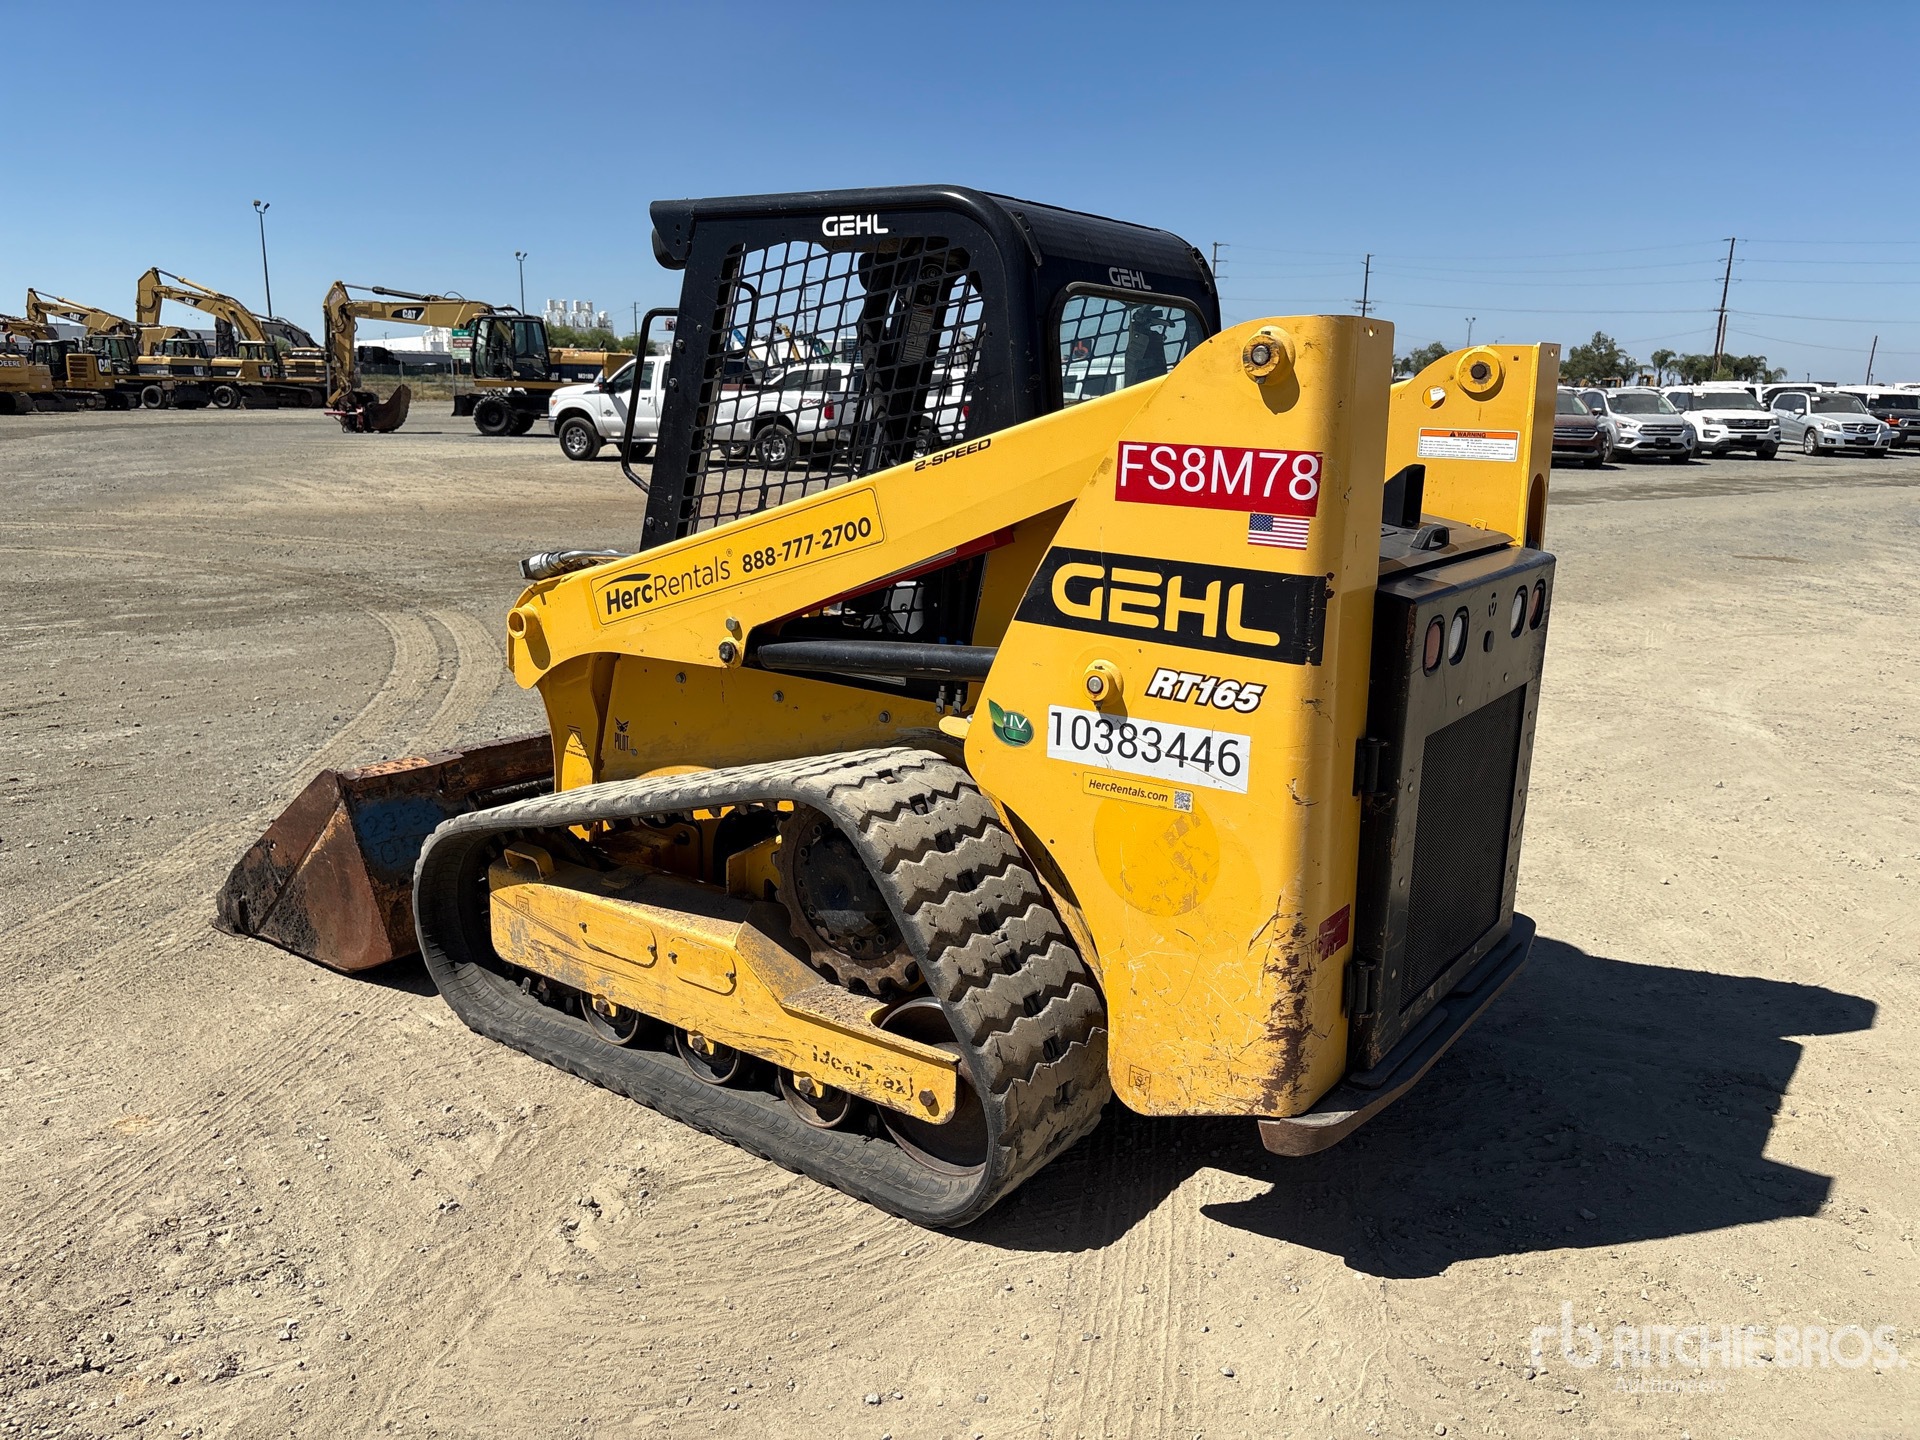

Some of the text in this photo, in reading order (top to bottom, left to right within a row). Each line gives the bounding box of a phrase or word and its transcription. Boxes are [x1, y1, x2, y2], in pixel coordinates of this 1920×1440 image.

[822, 213, 889, 237] GEHL
[1108, 266, 1152, 290] GEHL
[184, 297, 195, 306] CAT
[402, 308, 416, 319] CAT
[69, 312, 80, 321] CAT
[97, 358, 111, 373] CAT
[915, 438, 991, 472] 2-SPEED
[1120, 444, 1319, 500] FS8M78
[742, 517, 872, 573] 888-777-2700
[1051, 562, 1280, 646] GEHL
[1146, 667, 1267, 713] RT165
[1009, 714, 1028, 729] IV
[1050, 711, 1241, 777] 10383446
[1088, 778, 1168, 802] HercRentals.com
